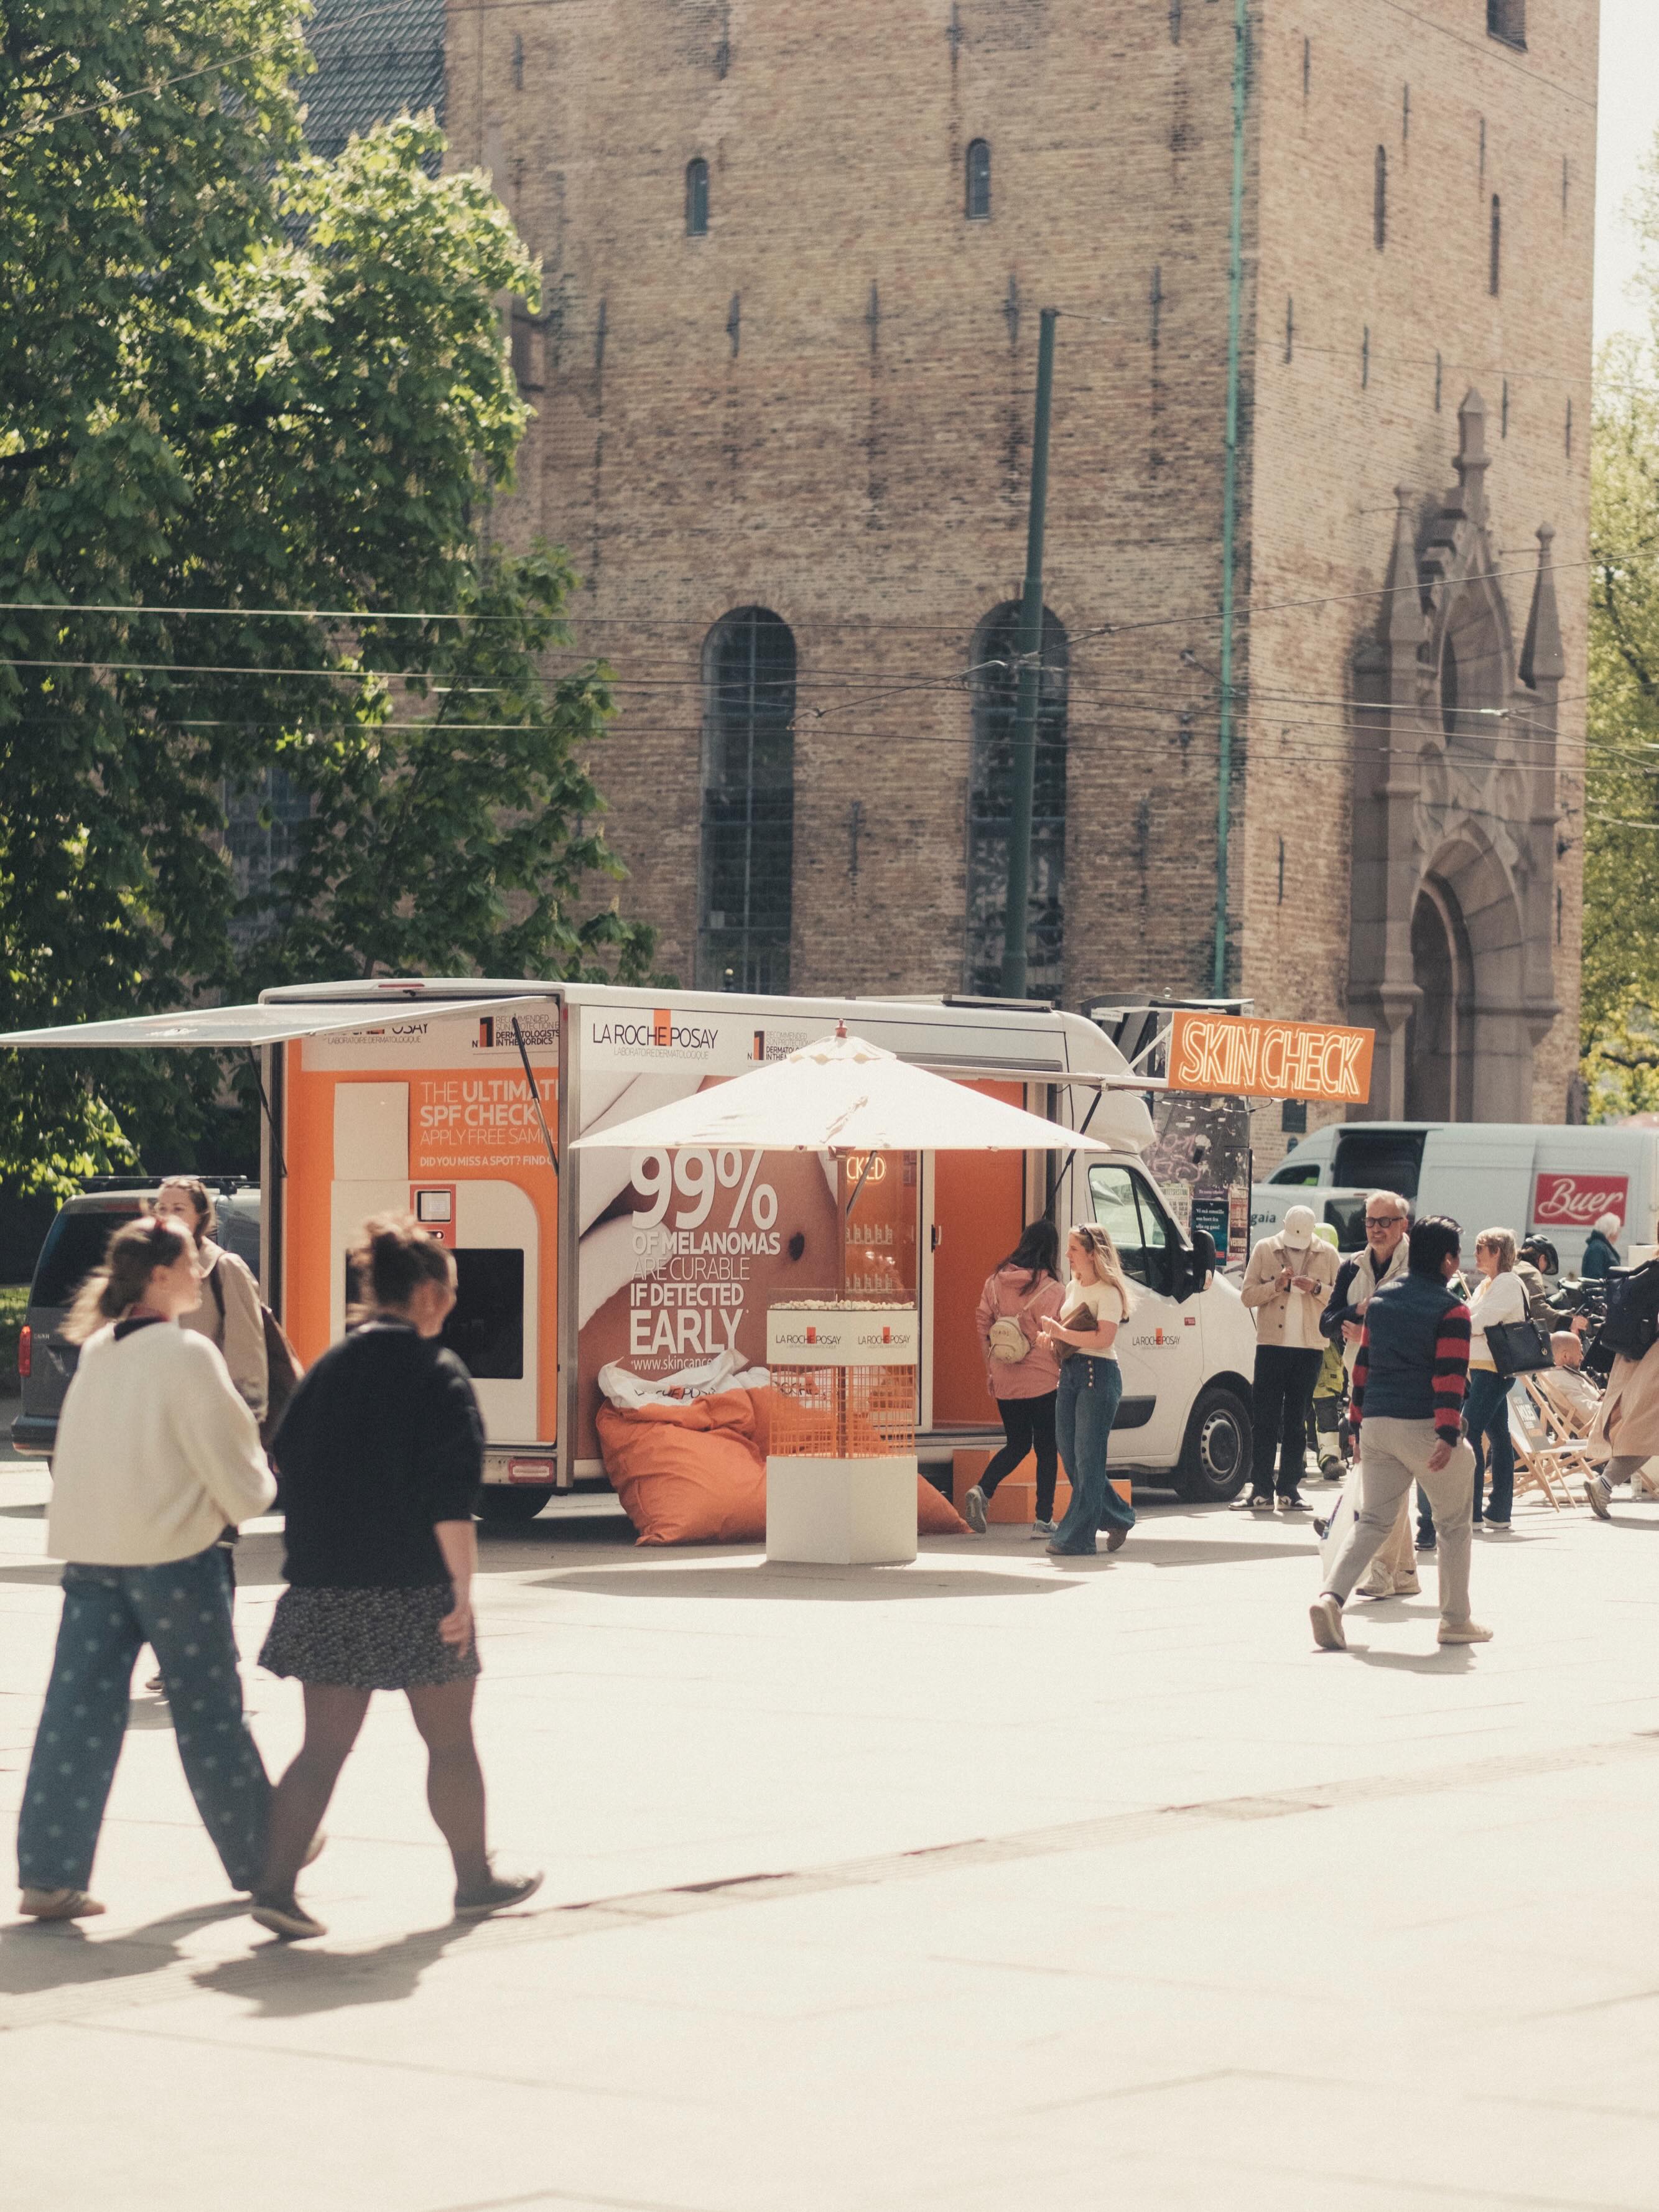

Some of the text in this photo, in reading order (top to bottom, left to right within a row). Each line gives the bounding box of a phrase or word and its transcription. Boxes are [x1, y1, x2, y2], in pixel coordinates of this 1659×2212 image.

[496, 1014, 549, 1023] RECMMENDED
[496, 1023, 510, 1031] SUN
[496, 1029, 559, 1039] DERMTOLOGISTS
[328, 1034, 421, 1045] LABORATOIRE DERMATOLOGIQUE
[496, 1039, 503, 1047] IN
[593, 1023, 718, 1049] LA ROCHE POSAY
[613, 1046, 709, 1061] LABORATOIRE DERMATOLOGIQUE
[1181, 1020, 1364, 1095] SKIN CHECK
[420, 1080, 458, 1104] THE
[419, 1103, 539, 1127] SPF CHECK
[419, 1128, 467, 1146] APPLY
[468, 1128, 506, 1145] FREE
[420, 1156, 435, 1167] DID
[436, 1156, 456, 1166] YOU
[457, 1156, 481, 1166] MISS
[482, 1156, 489, 1166] A
[523, 1155, 546, 1166] FIND
[630, 1148, 778, 1230] 99%
[1538, 1178, 1624, 1220] Buer
[1250, 1211, 1276, 1226] gaia
[632, 1232, 781, 1255] OF MELANOMAS
[631, 1257, 750, 1281] ARE CURABLE
[630, 1283, 744, 1306] IF DETECTED
[776, 1334, 842, 1345] LA ROCHE POSAY
[858, 1335, 911, 1344] LA ROCHE POSAY
[1132, 1336, 1181, 1346] LA ROCHE POSAY
